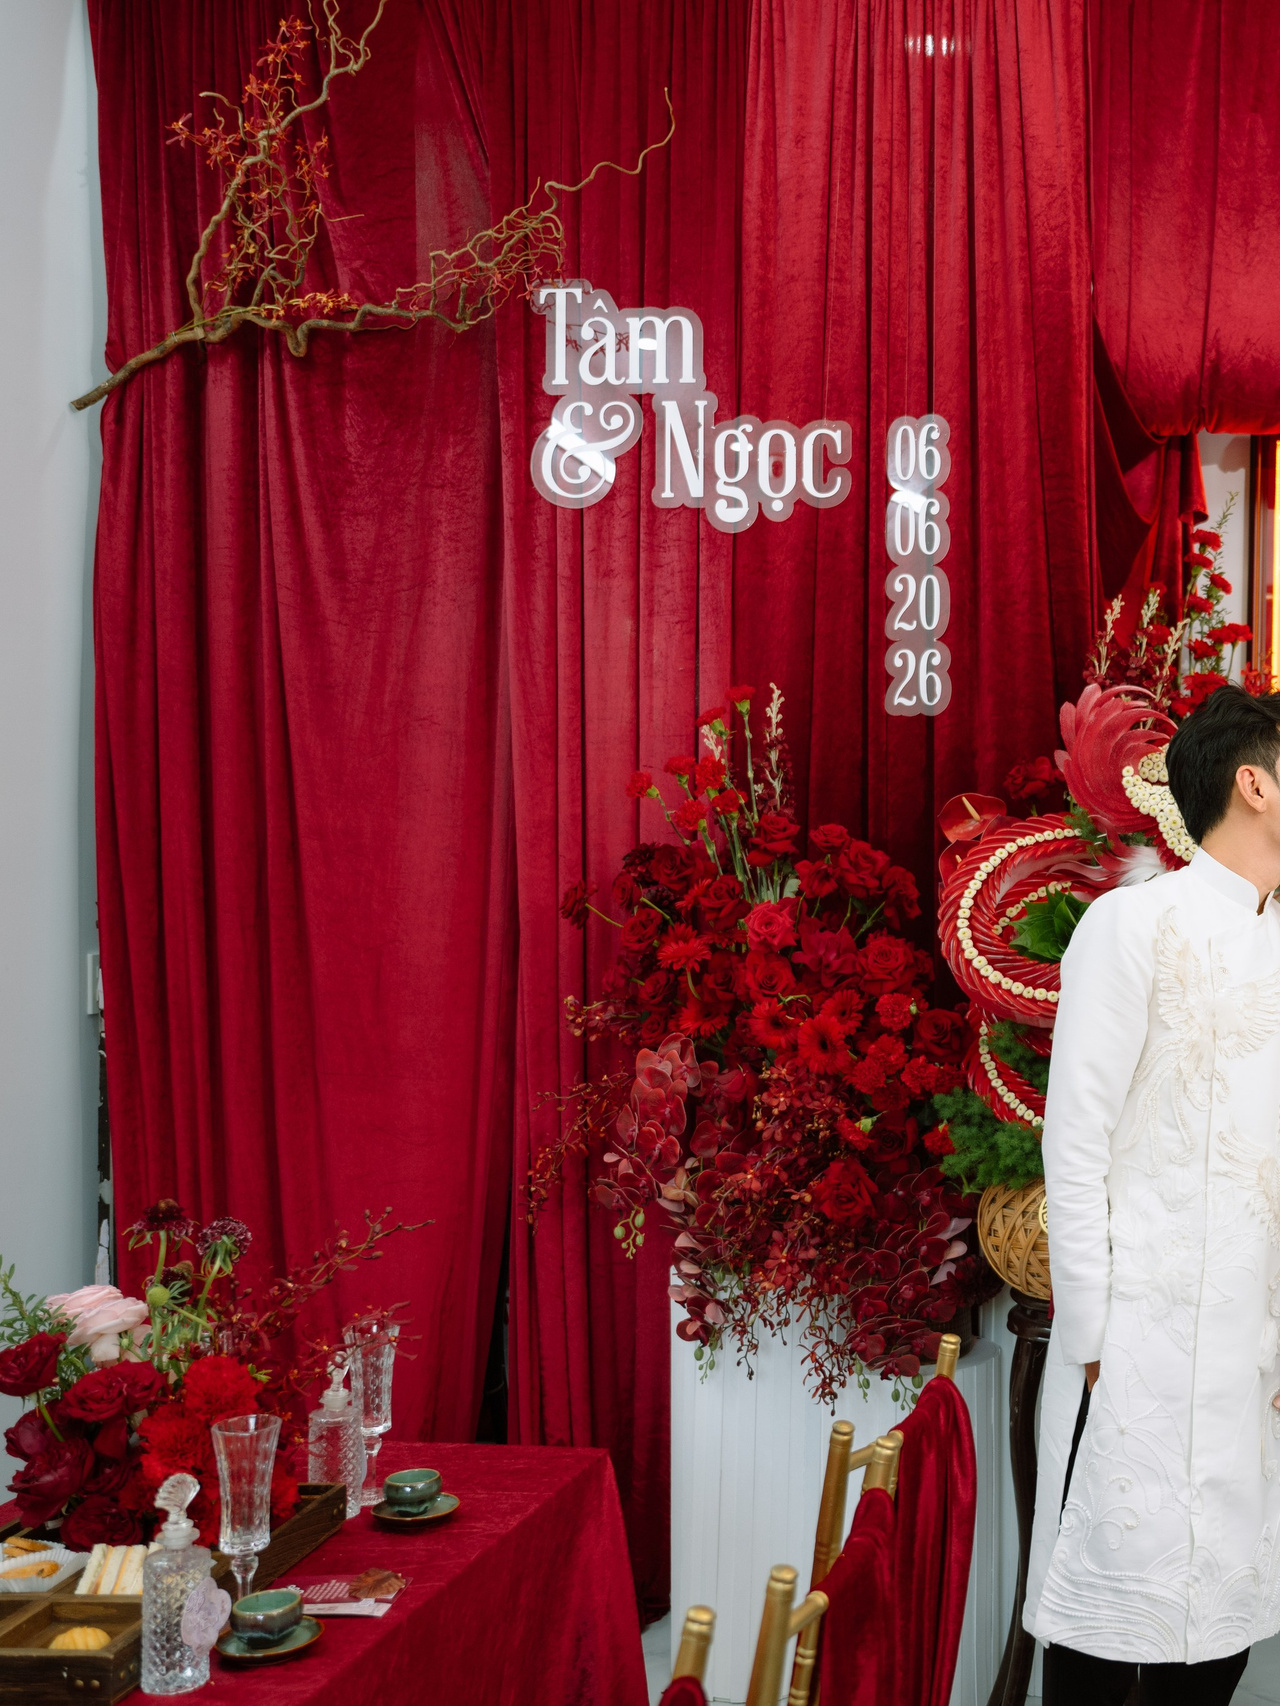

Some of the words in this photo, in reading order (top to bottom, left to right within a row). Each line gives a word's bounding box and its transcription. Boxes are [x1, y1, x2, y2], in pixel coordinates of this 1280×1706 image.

[540, 288, 696, 386] Tâm
[542, 401, 635, 498] &
[662, 401, 842, 522] Ngọc
[894, 424, 942, 480] 06
[894, 499, 942, 555] 06
[894, 574, 941, 630] 20
[894, 648, 942, 706] 26
